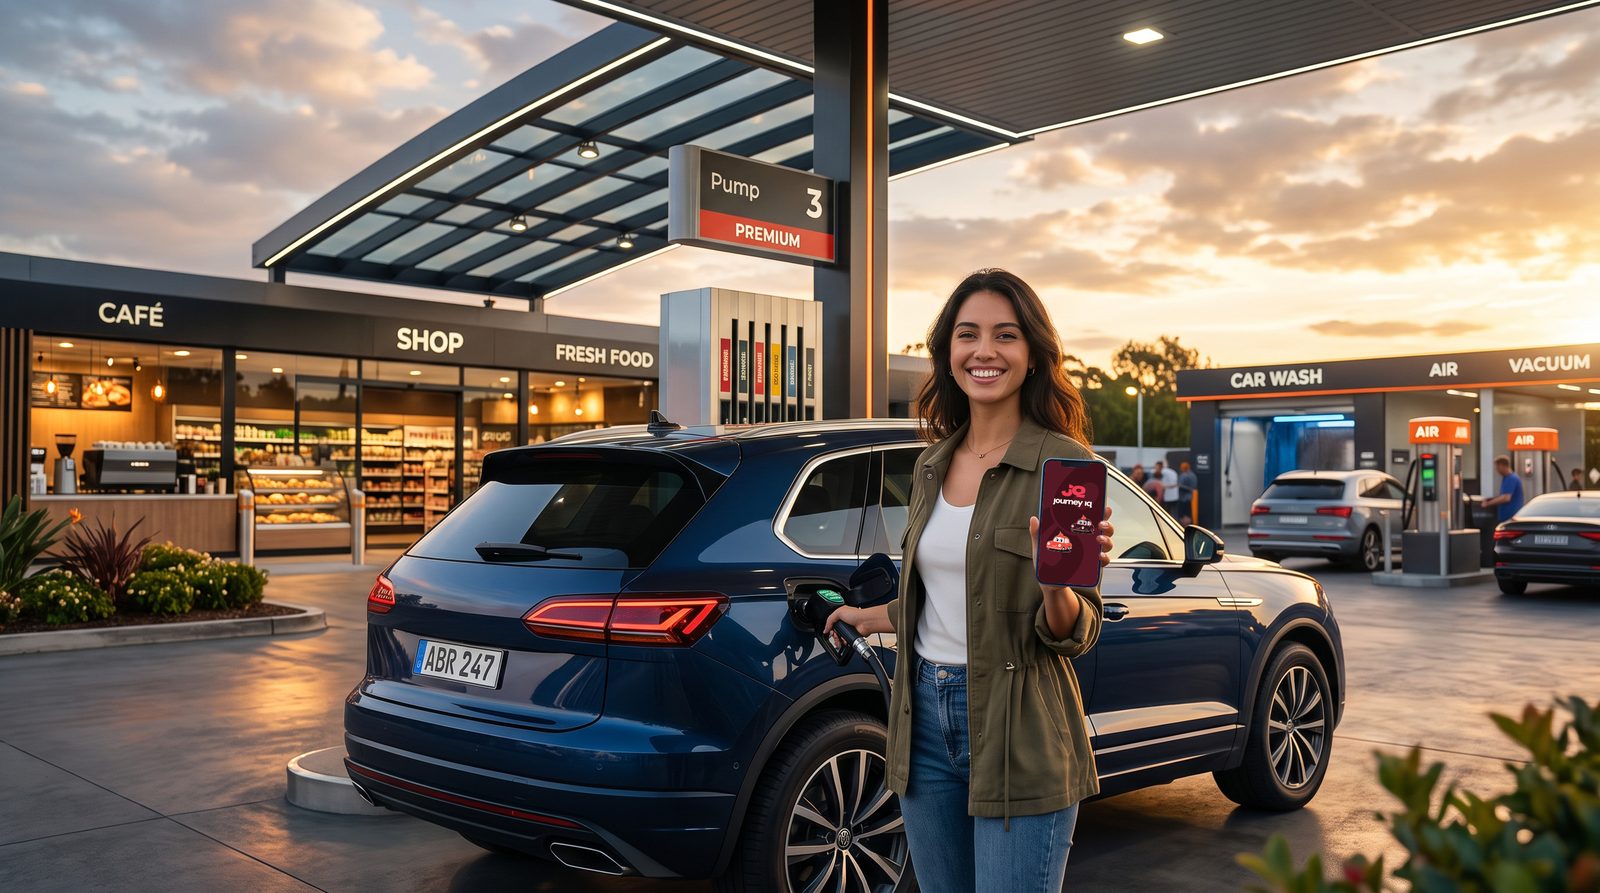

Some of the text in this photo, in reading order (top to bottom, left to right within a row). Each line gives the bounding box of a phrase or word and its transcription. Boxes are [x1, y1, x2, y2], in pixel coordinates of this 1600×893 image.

[711, 171, 823, 219] Pump 3
[735, 222, 801, 249] PREMIUM
[98, 301, 164, 328] CAFÉ
[396, 327, 464, 354] SHOP
[555, 343, 654, 368] FRESH FOOD
[1508, 353, 1591, 374] VACUUM
[1230, 367, 1324, 389] CAR WASH
[1428, 361, 1459, 378] AIR
[1415, 425, 1440, 438] AIR
[1514, 434, 1535, 446] AIR
[1053, 498, 1083, 507] journey
[424, 646, 495, 680] ABR 247
